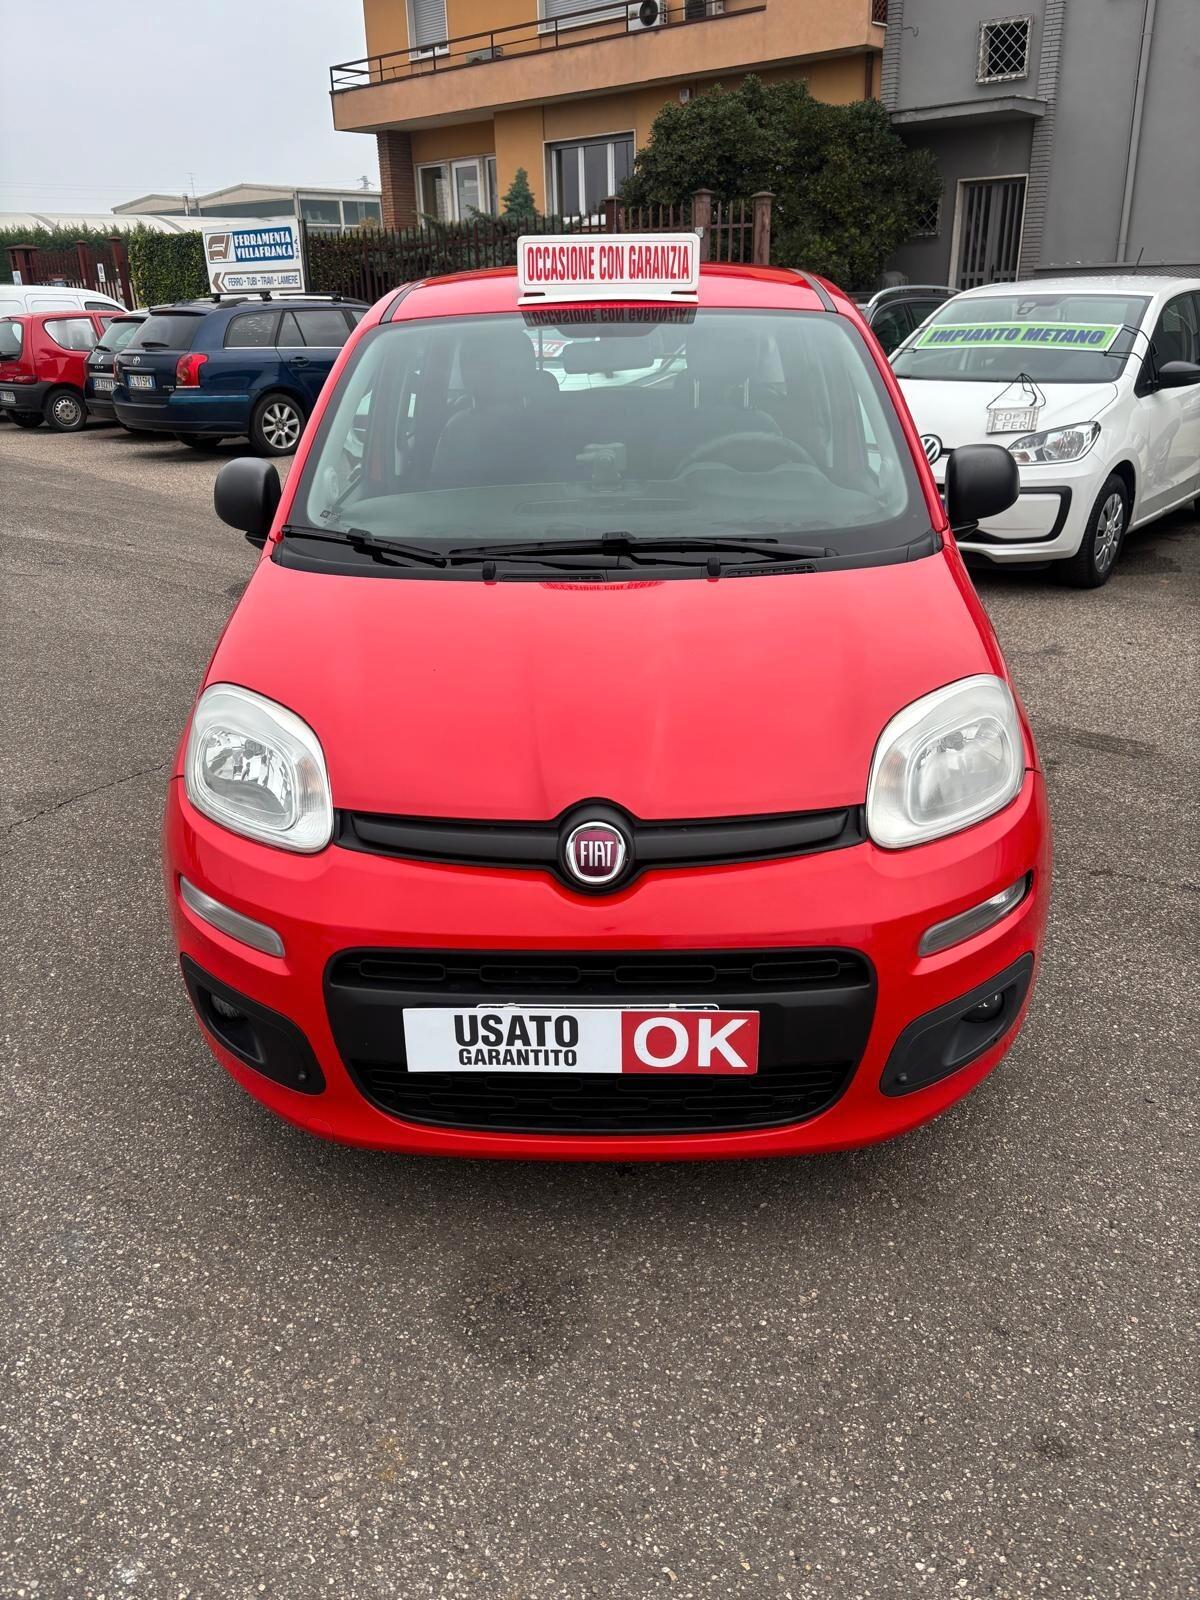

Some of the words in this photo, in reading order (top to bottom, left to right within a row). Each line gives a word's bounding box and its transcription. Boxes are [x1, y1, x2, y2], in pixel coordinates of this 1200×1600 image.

[234, 231, 291, 246] FERRAMENTA
[235, 245, 293, 259] VILLAFRANCA
[527, 246, 595, 281] OCCASIONE
[599, 245, 624, 280] CON
[628, 245, 690, 280] GARANZIA
[928, 327, 1021, 343] IMPIANTO
[1023, 327, 1106, 344] METANO
[580, 841, 614, 867] FIAT
[454, 1014, 579, 1048] USATO
[633, 1016, 749, 1068] OK
[458, 1048, 577, 1067] GARANTITO
